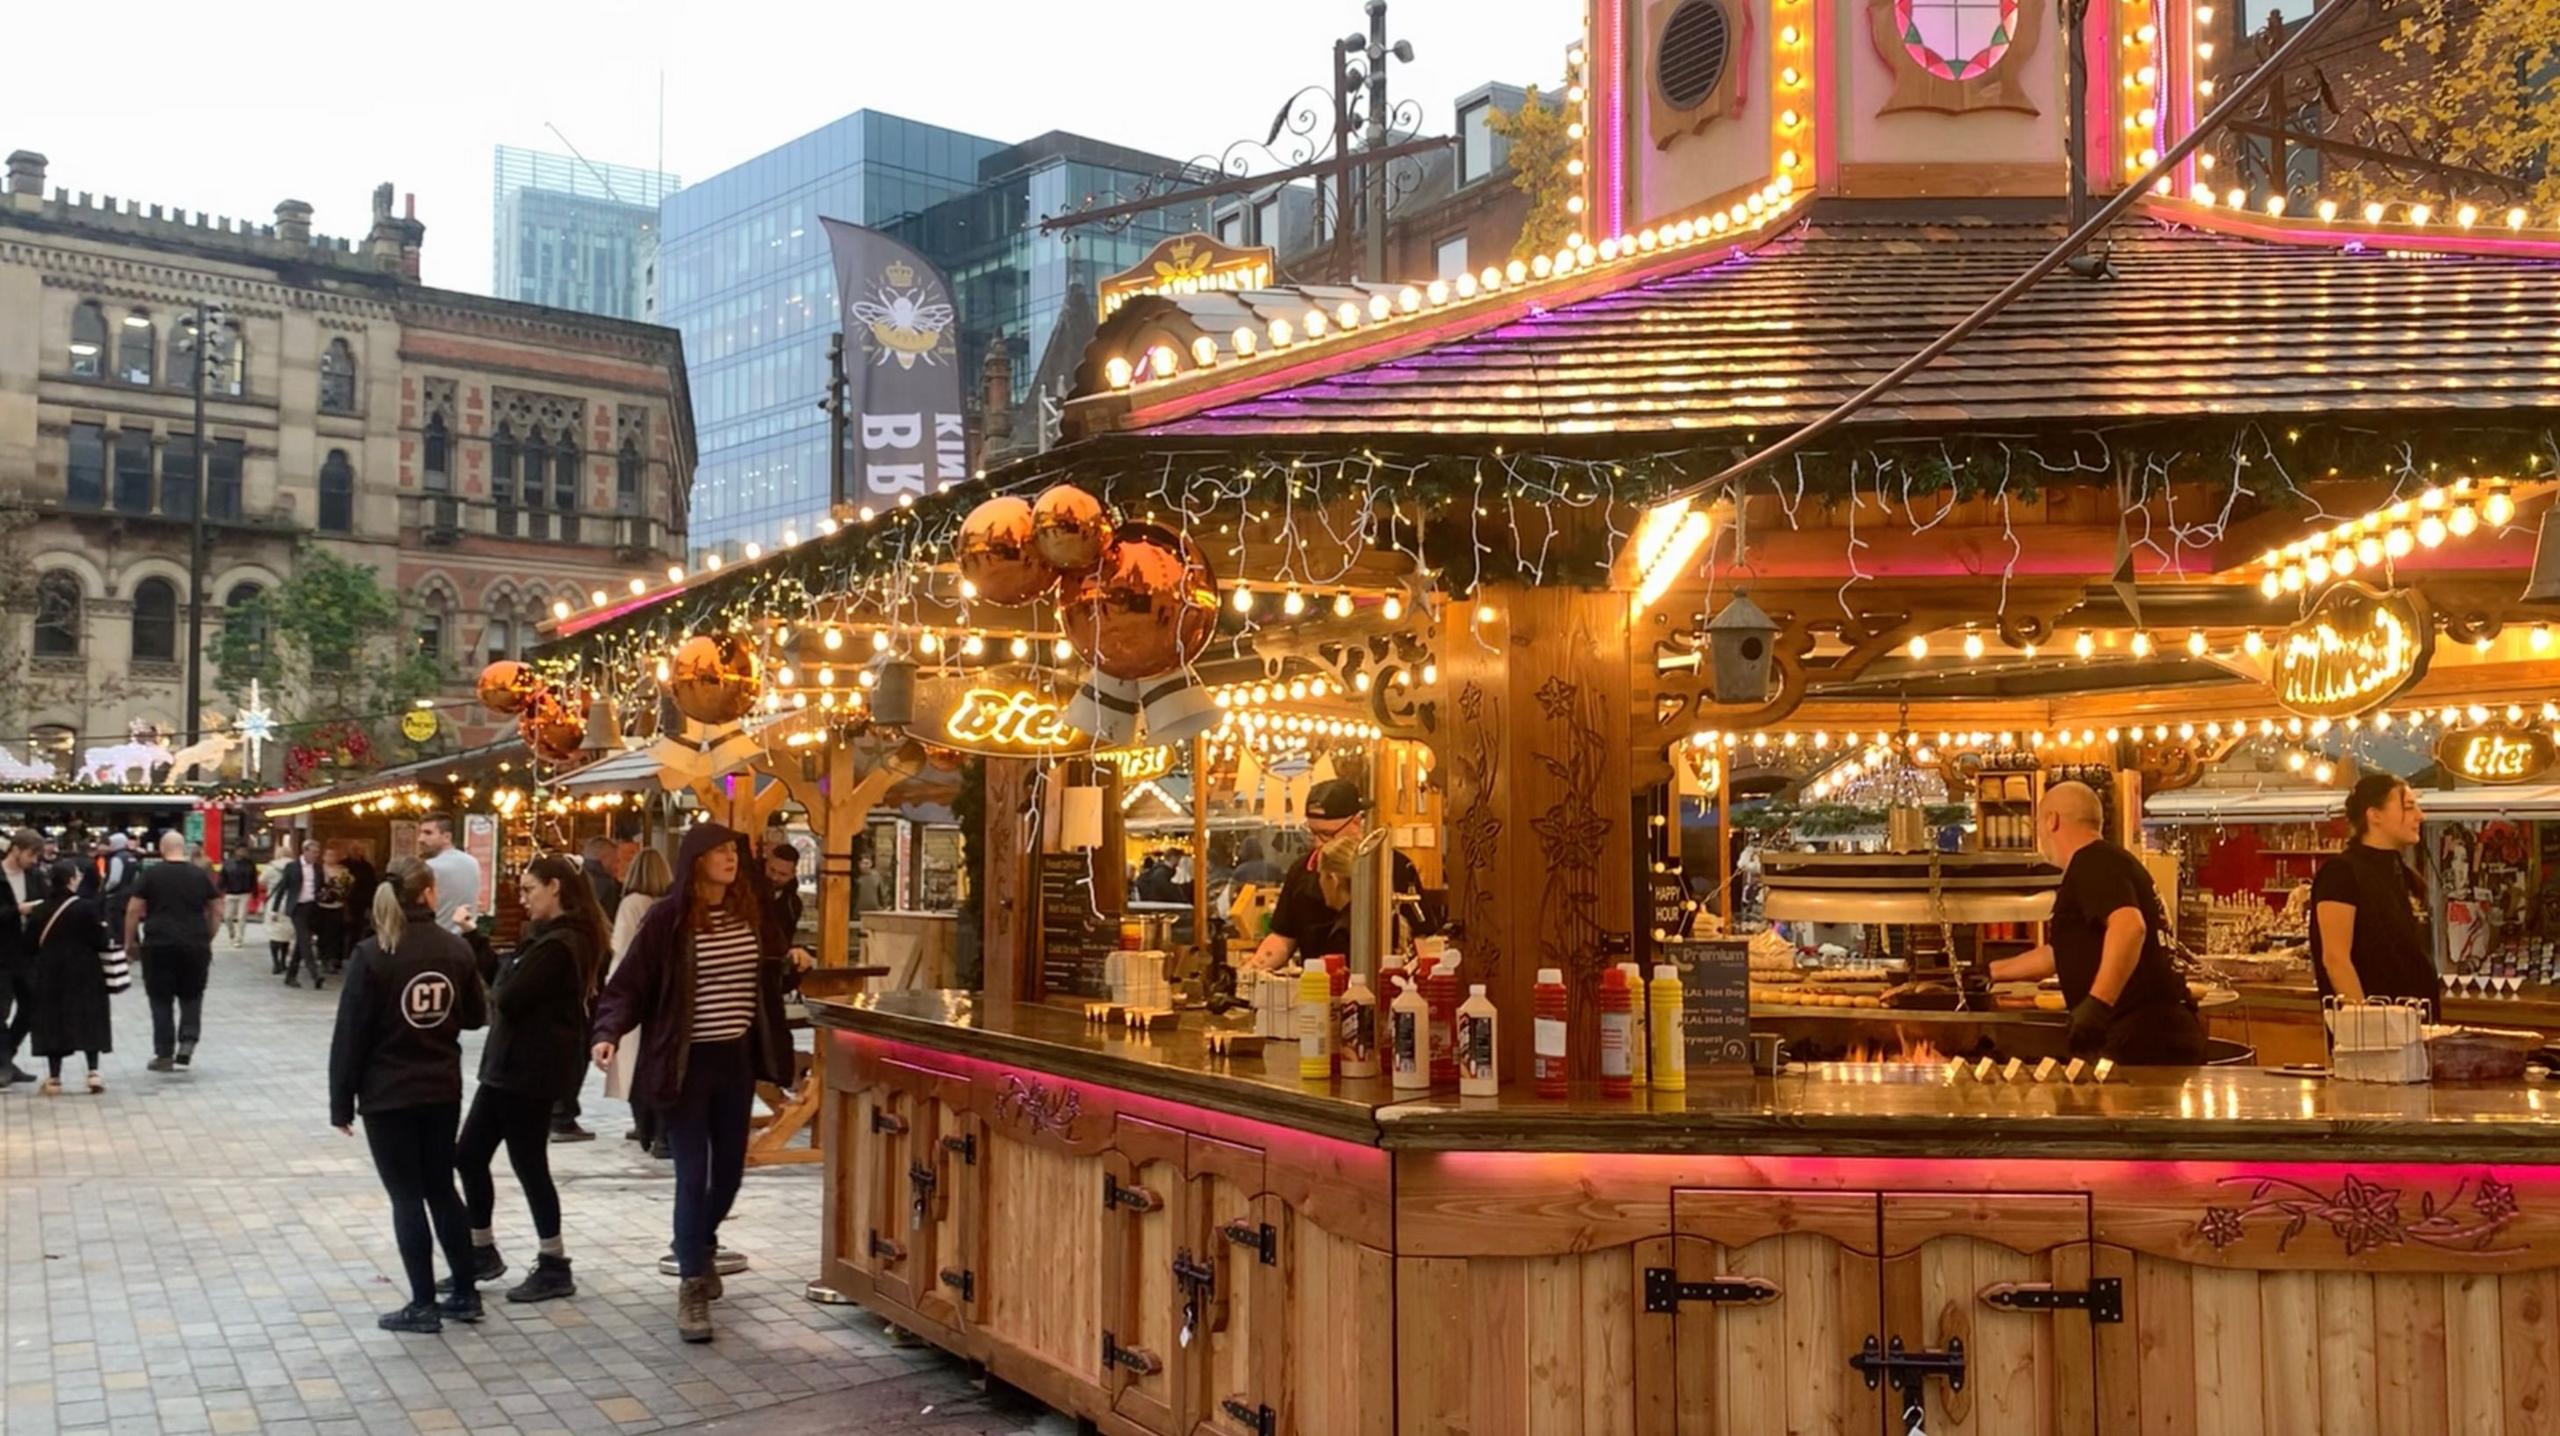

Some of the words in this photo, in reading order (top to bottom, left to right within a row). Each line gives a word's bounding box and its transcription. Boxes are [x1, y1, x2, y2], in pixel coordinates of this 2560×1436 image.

[1655, 886, 1681, 901] HAPPY
[1655, 906, 1680, 921] HOUR
[1683, 948, 1745, 962] Premium
[412, 982, 446, 1012] CT
[1684, 988, 1704, 998] LAL
[1706, 988, 1724, 998] Hot
[1725, 988, 1745, 1000] Dog
[1684, 1016, 1704, 1026] LAL
[1706, 1016, 1724, 1026] Hot
[1725, 1016, 1745, 1028] Dog
[1685, 1035, 1723, 1046] rywurst
